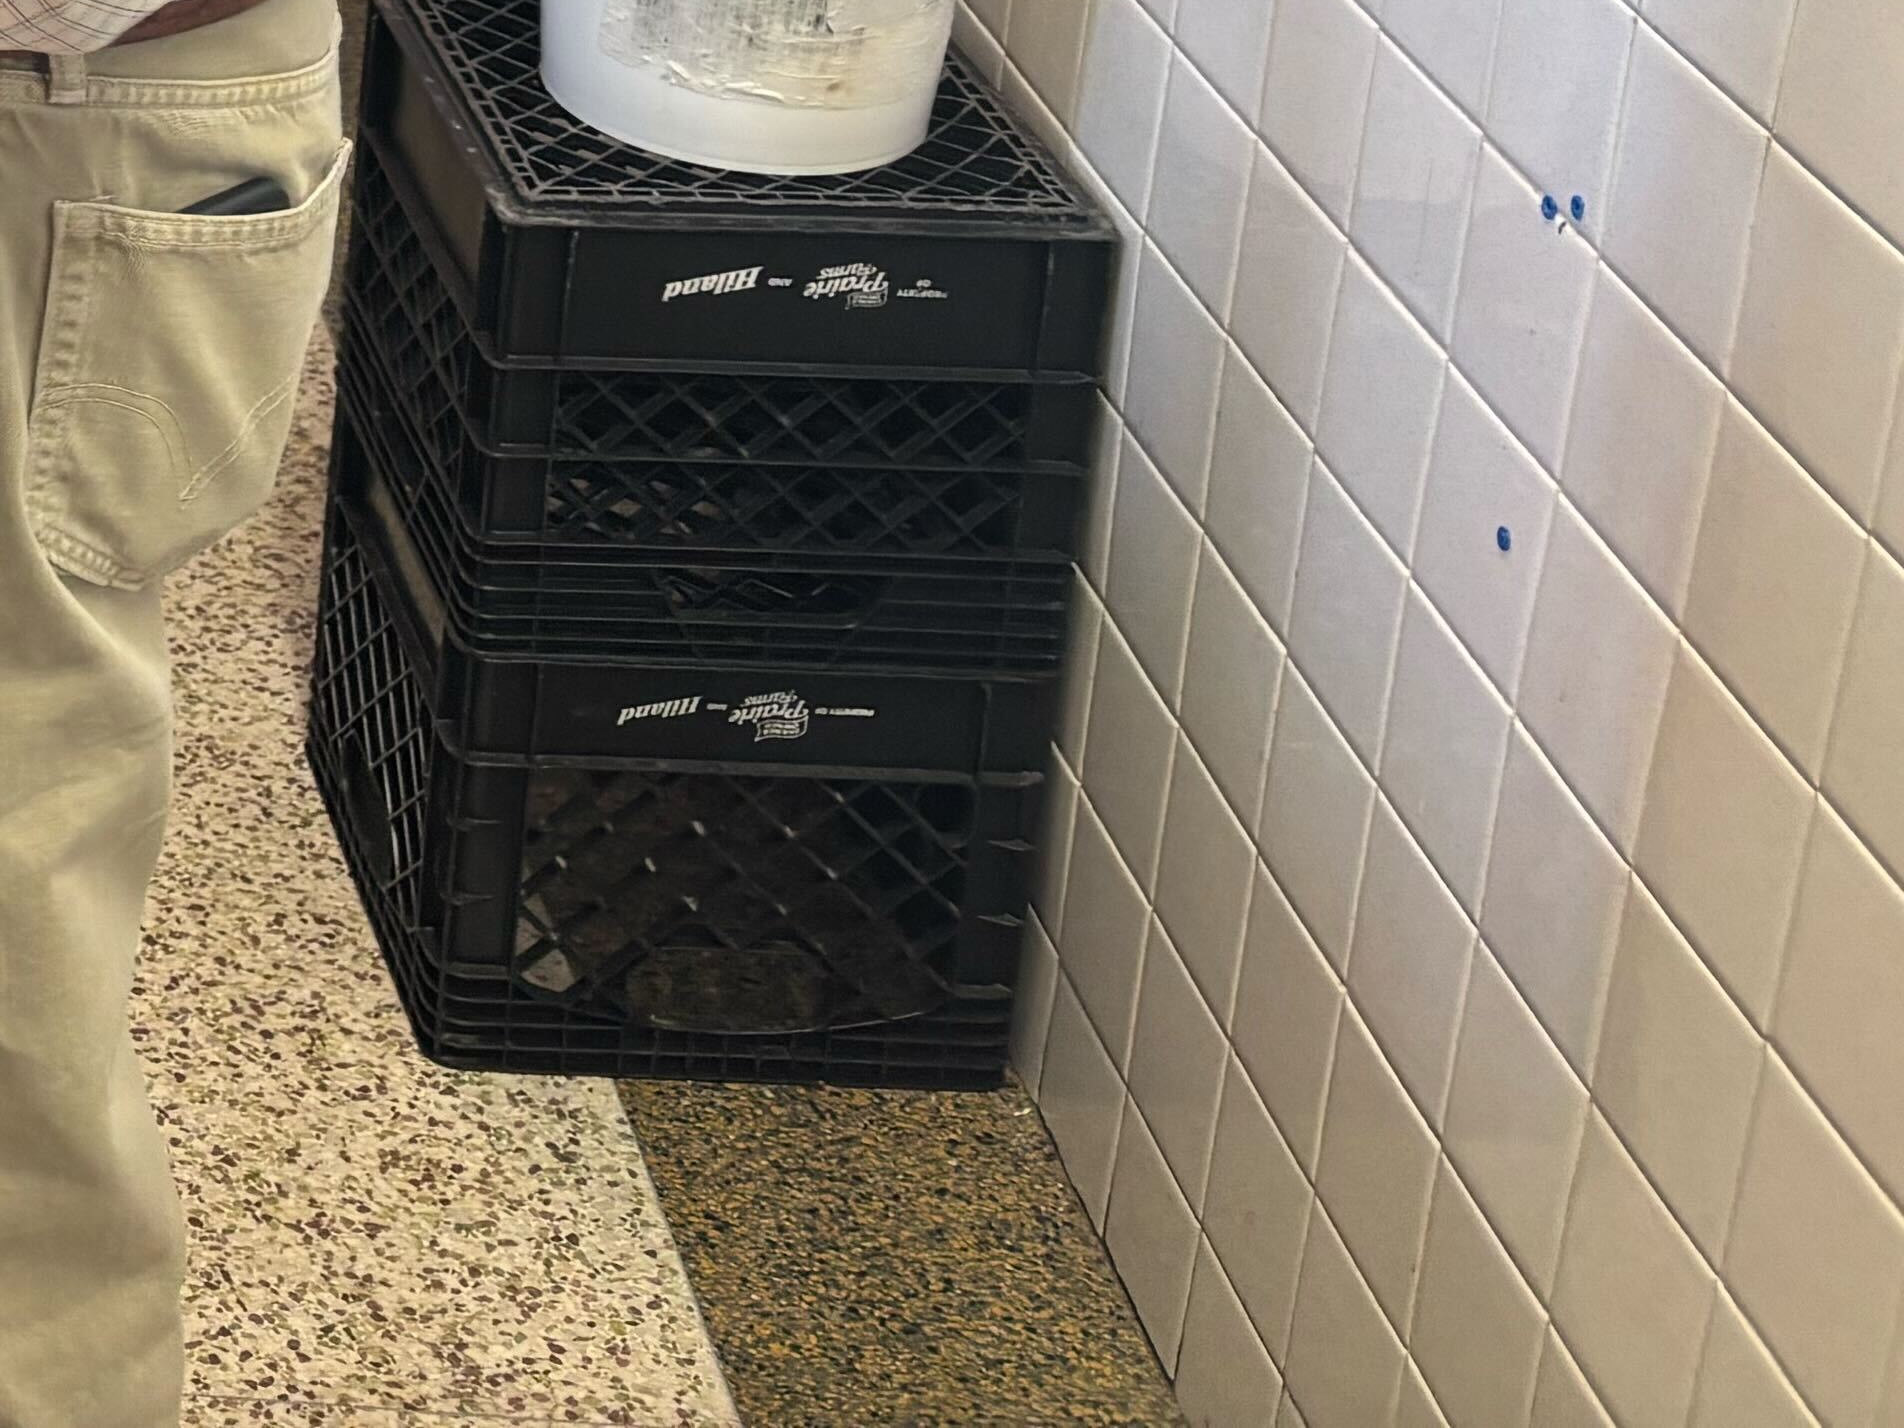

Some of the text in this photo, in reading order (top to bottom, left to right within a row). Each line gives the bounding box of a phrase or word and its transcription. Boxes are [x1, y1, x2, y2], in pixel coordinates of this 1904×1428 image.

[660, 265, 766, 303] Hiland
[802, 271, 890, 301] Prairie
[815, 262, 878, 280] Farms
[616, 695, 703, 727] Hiland
[728, 700, 810, 726] Prairie
